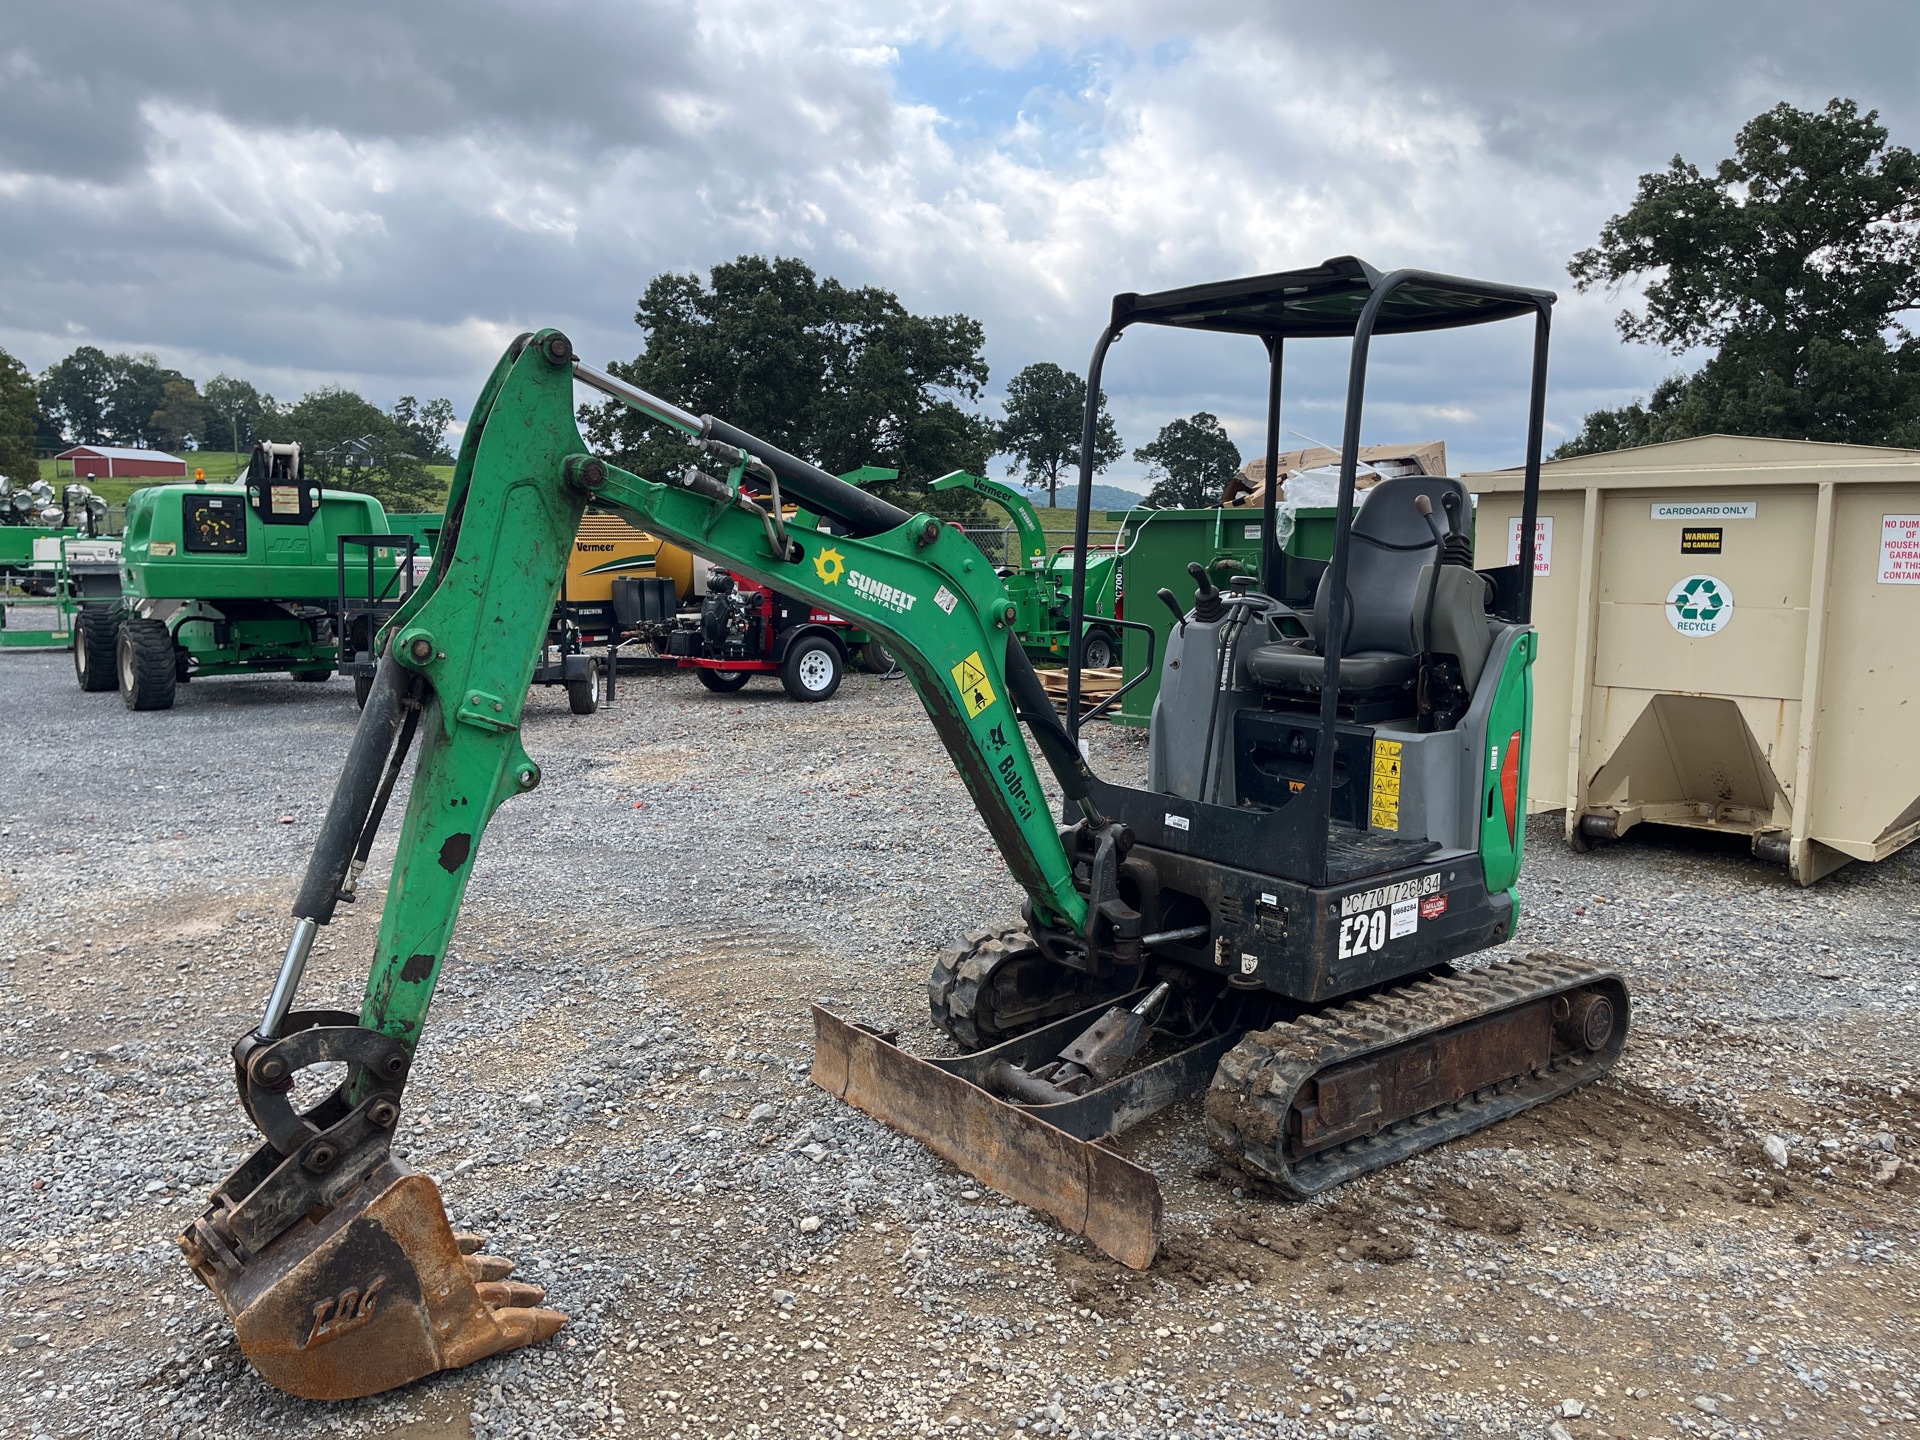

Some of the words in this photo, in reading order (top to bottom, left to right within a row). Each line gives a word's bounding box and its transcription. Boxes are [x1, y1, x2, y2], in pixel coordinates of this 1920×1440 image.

[974, 478, 1012, 502] Vermeer
[1659, 507, 1720, 515] CARDBOARD
[1722, 506, 1748, 514] ONLY
[1884, 520, 1897, 528] NO
[1537, 533, 1545, 541] IN
[1684, 532, 1720, 541] WARNING
[1905, 530, 1917, 539] OF
[267, 537, 310, 553] JLG
[576, 542, 615, 552] Vermeer
[1889, 551, 1920, 559] GARBA
[1892, 561, 1902, 569] IN
[846, 569, 917, 611] SUNBELT
[854, 588, 904, 614] RENTALS
[1677, 621, 1717, 632] RECYCLE
[1338, 910, 1387, 960] E20
